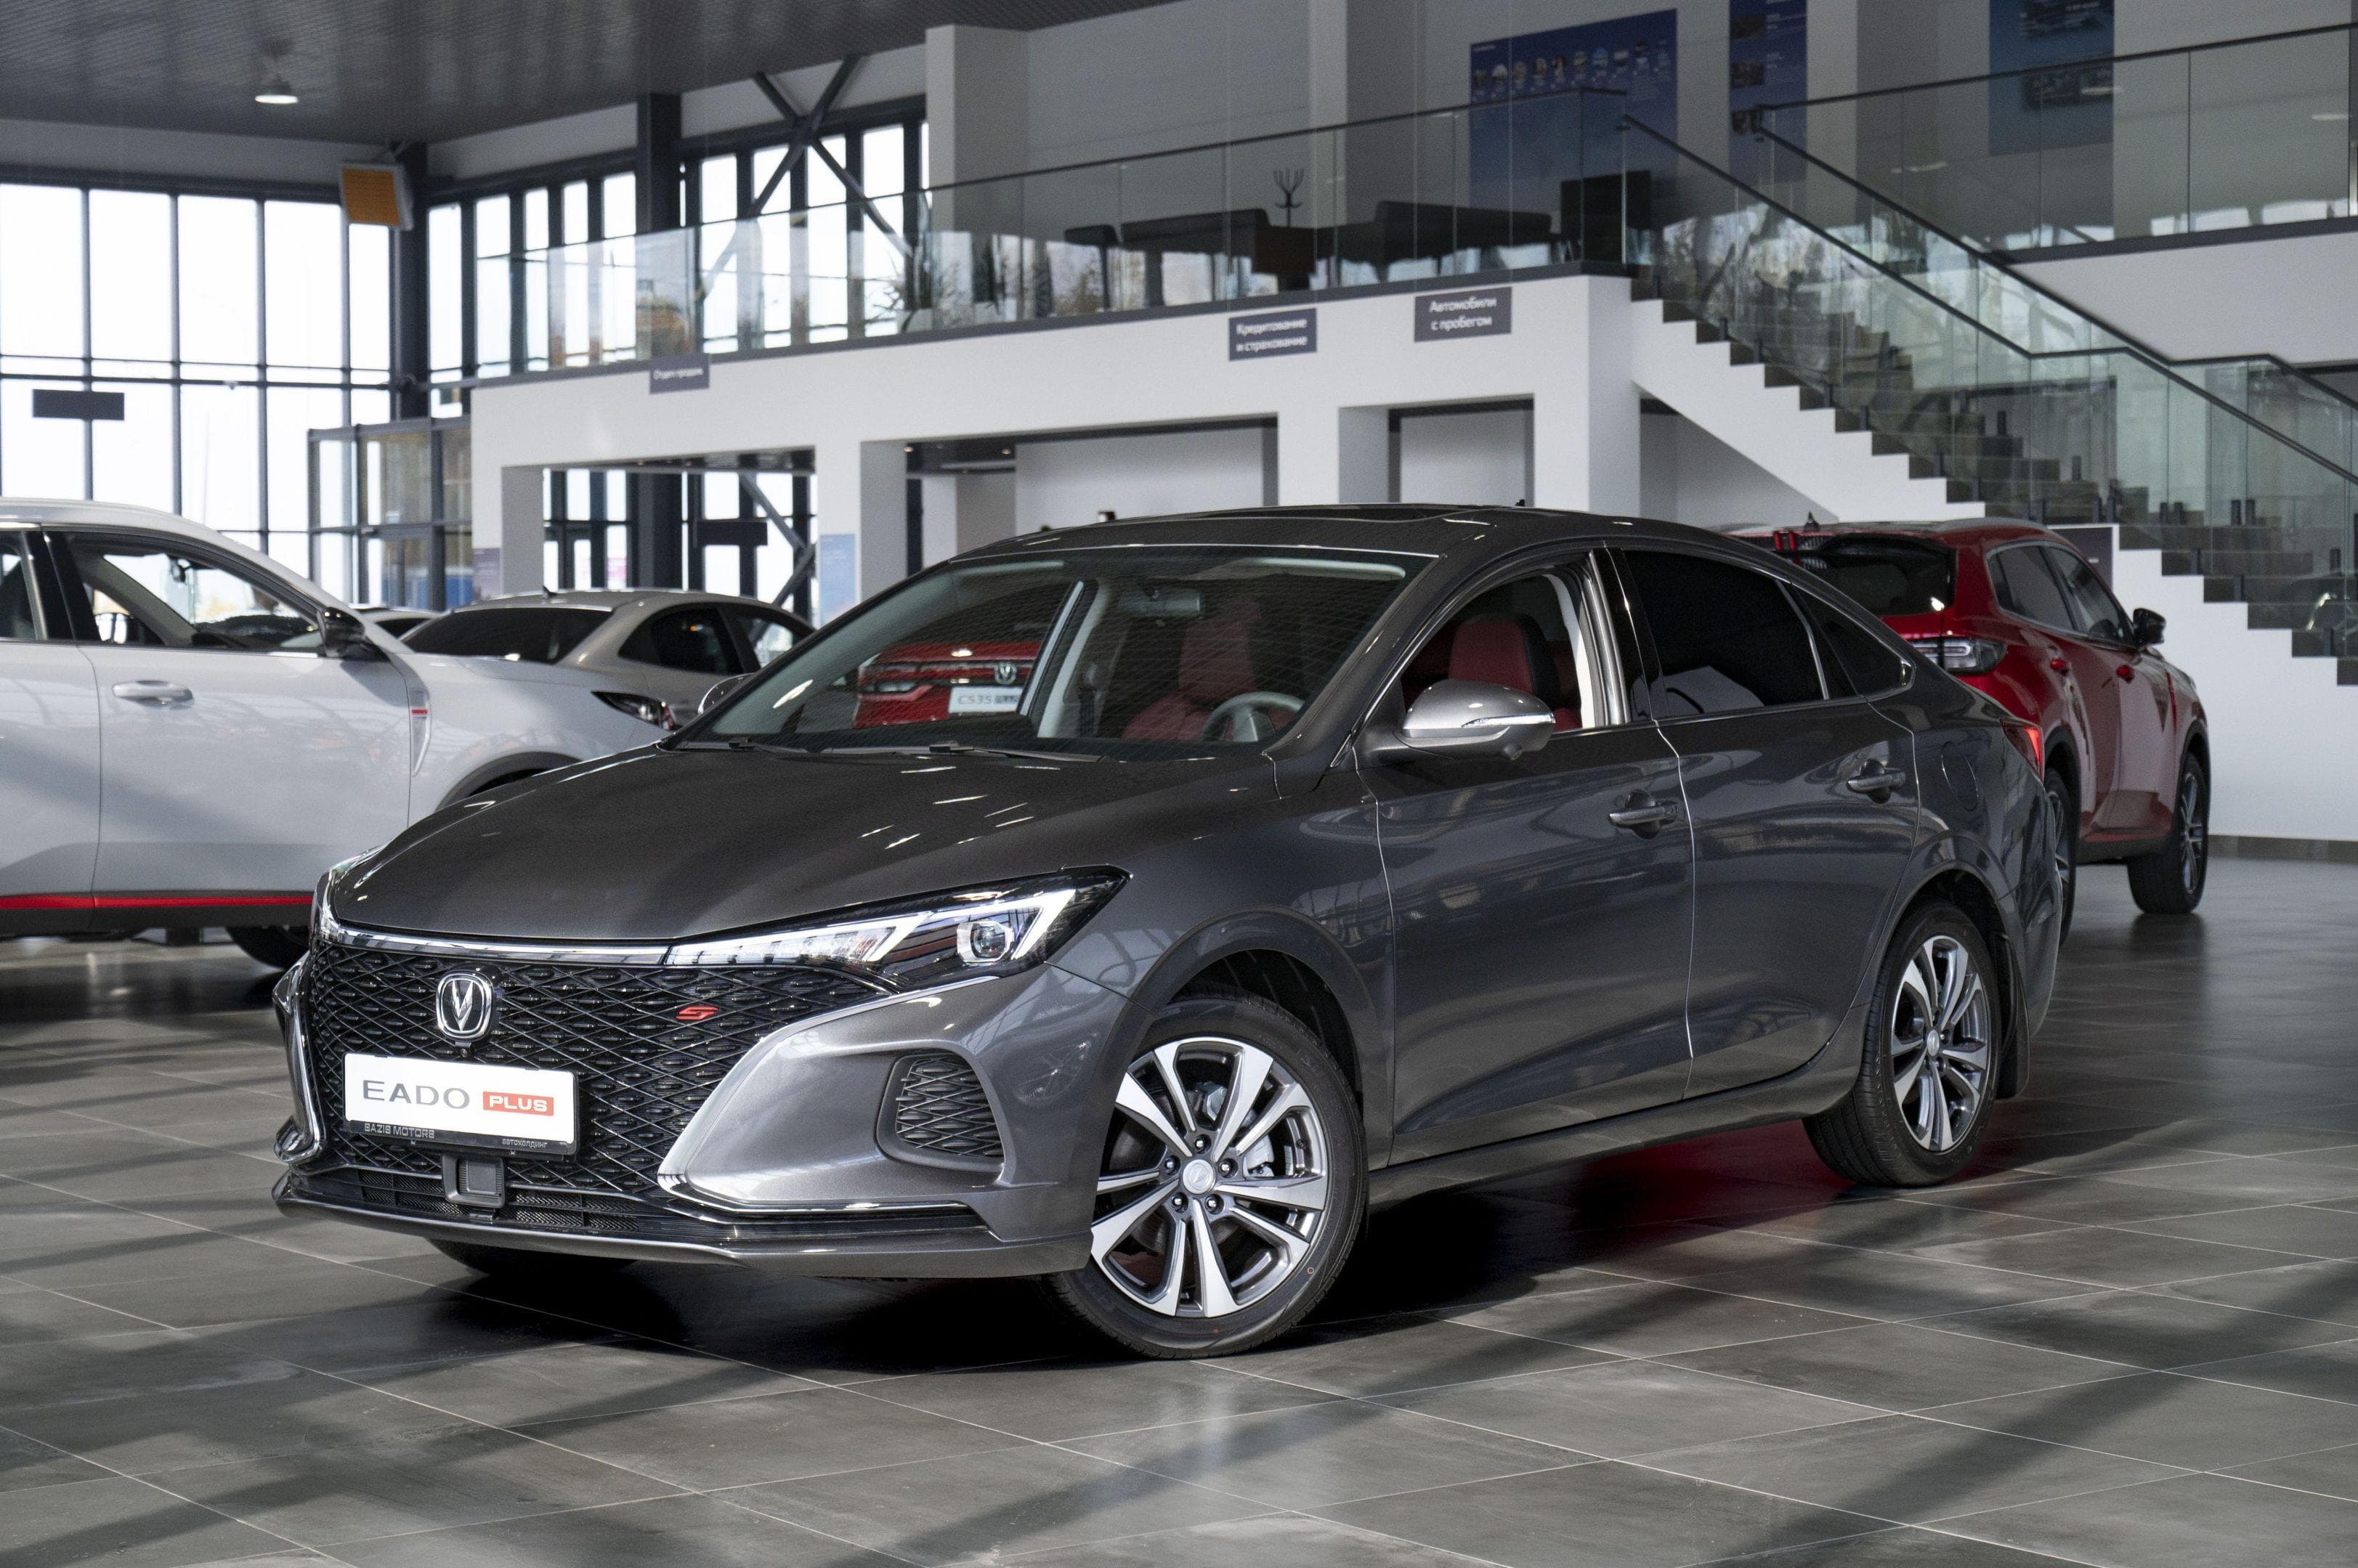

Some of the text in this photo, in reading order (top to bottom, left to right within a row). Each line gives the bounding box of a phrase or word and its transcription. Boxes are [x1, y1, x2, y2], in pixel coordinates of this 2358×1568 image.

[1429, 296, 1497, 312] Автомобили
[1430, 314, 1493, 332] с пробегом
[363, 1080, 548, 1112] EADO PLUS
[364, 1122, 435, 1140] BAZIS MOTORS
[502, 1138, 548, 1148] автохолдинг
